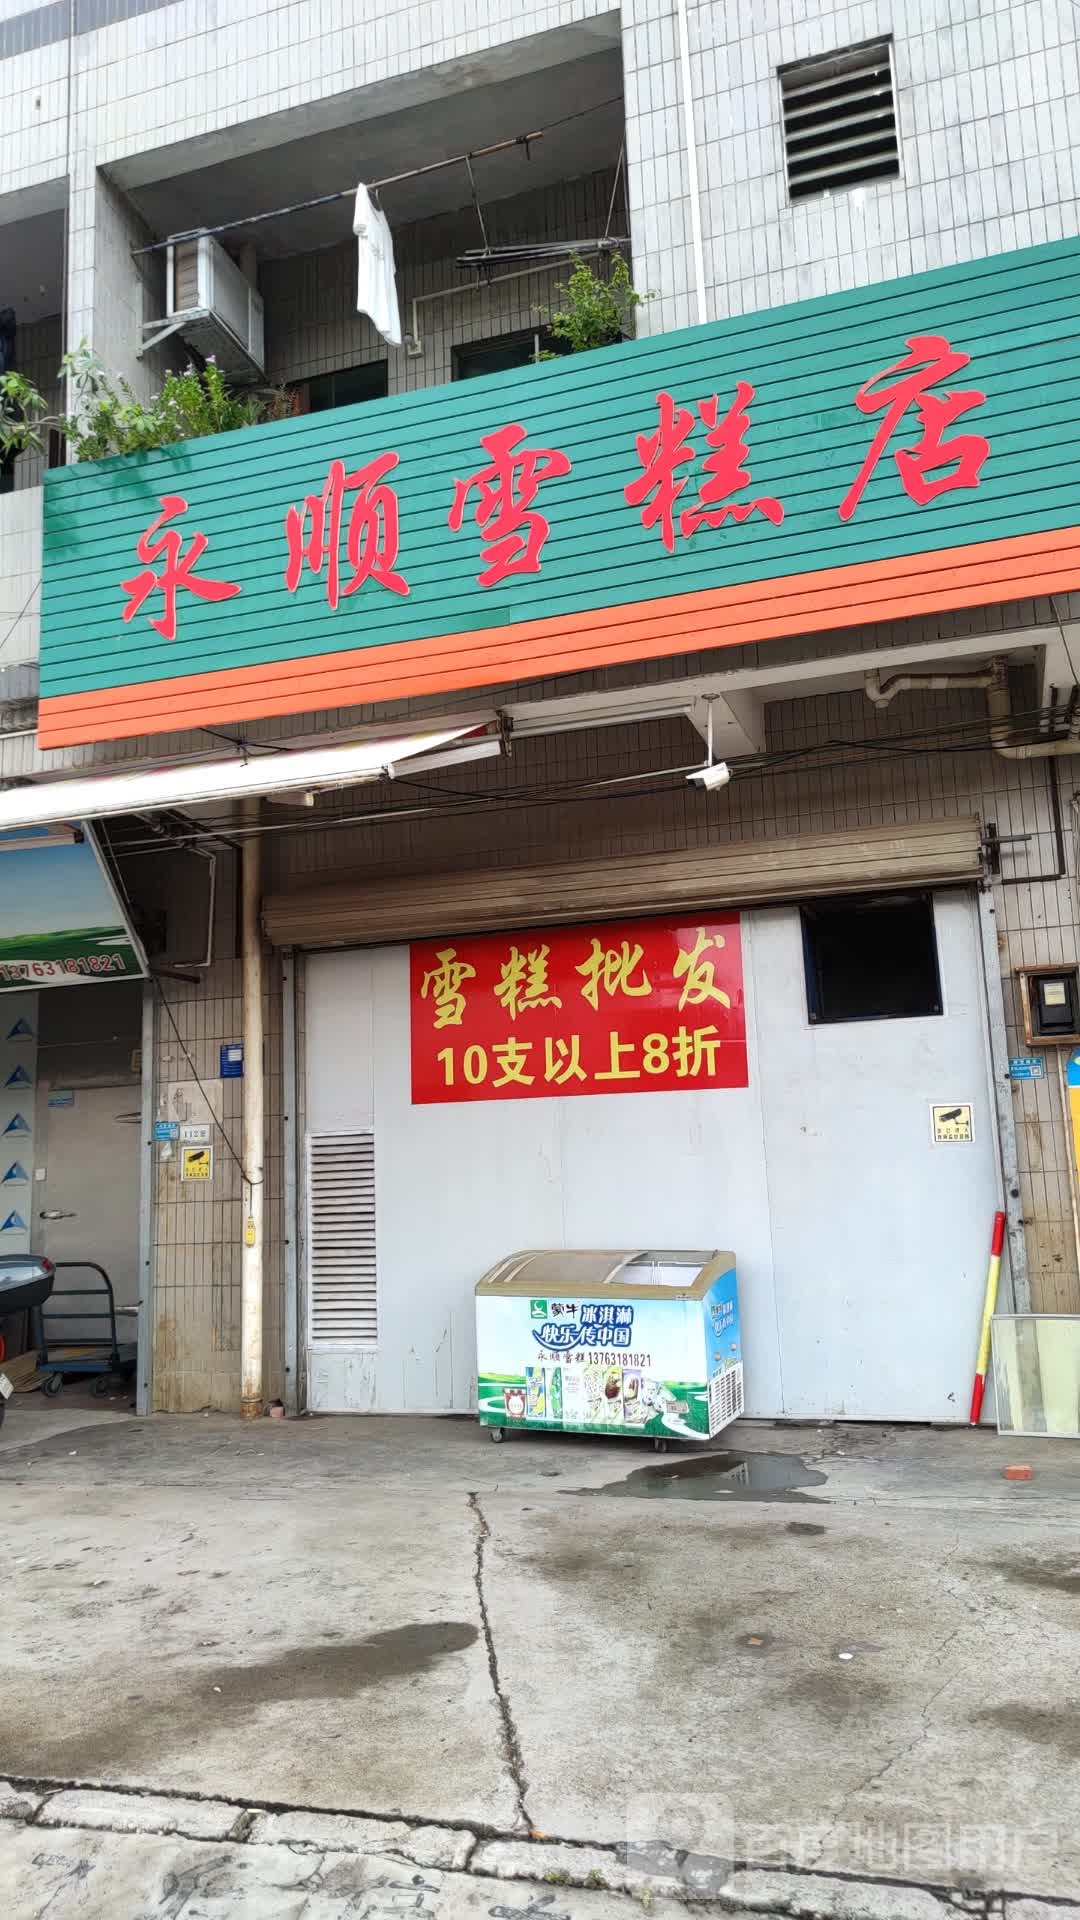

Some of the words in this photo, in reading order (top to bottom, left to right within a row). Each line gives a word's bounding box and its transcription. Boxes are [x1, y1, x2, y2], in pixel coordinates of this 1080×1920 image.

[121, 334, 992, 641] 永顺雪糕店
[420, 926, 731, 1029] 雪糕批发
[436, 1024, 721, 1088] 10支以上8折
[538, 1323, 632, 1347] 快乐传中国
[551, 1302, 578, 1319] 蒙牛
[580, 1304, 633, 1326] 冰淇淋
